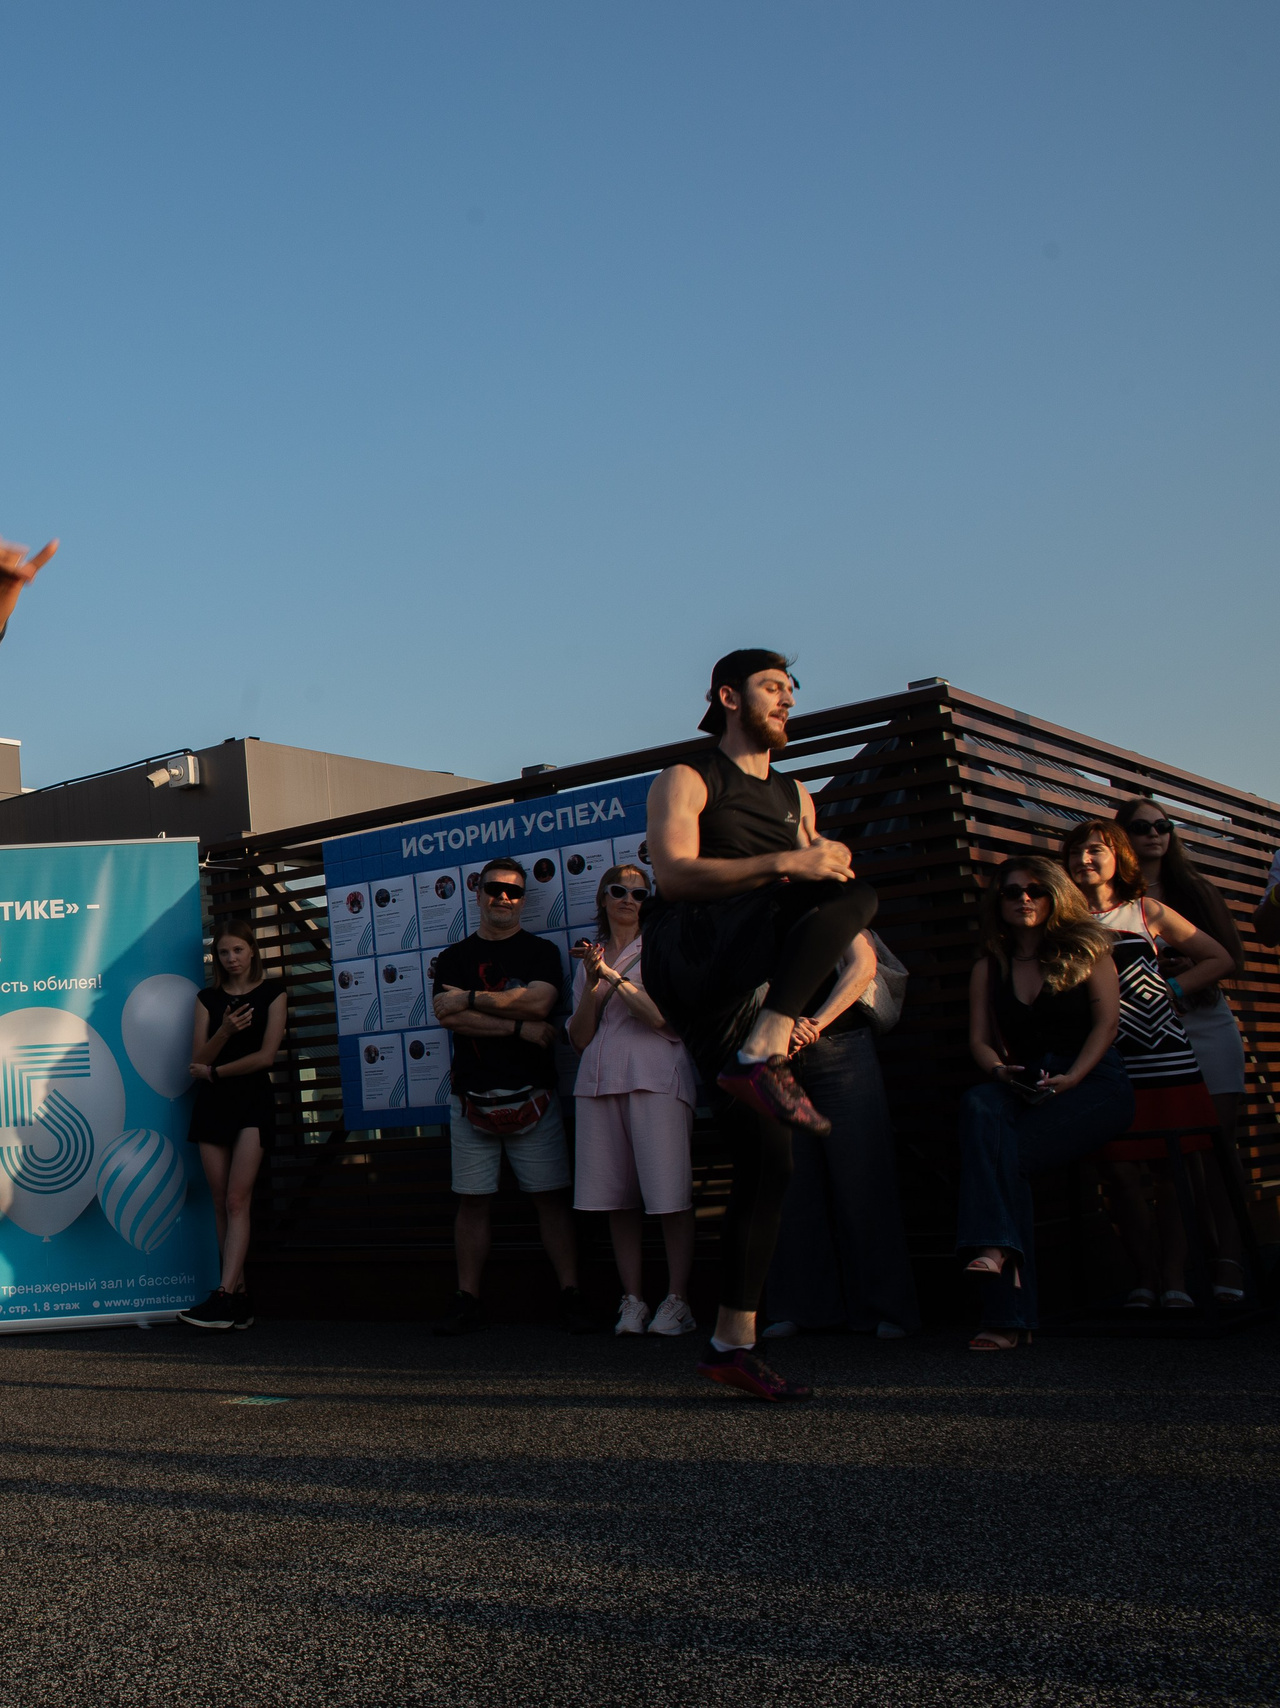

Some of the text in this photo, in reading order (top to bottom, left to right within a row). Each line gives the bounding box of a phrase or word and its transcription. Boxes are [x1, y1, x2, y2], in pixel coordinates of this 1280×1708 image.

[402, 797, 626, 858] ИСТОРИИ УСПЕХА
[34, 974, 102, 991] юбилея!
[1, 1277, 97, 1298] тренажерный
[100, 1279, 123, 1290] зал
[127, 1279, 135, 1288] и
[138, 1272, 195, 1287] бассейн
[8, 1305, 31, 1315] стр.
[33, 1303, 40, 1313] 1,
[43, 1302, 50, 1311] 8
[53, 1302, 80, 1311] этаж
[104, 1294, 196, 1307] www.gymatica.ru
